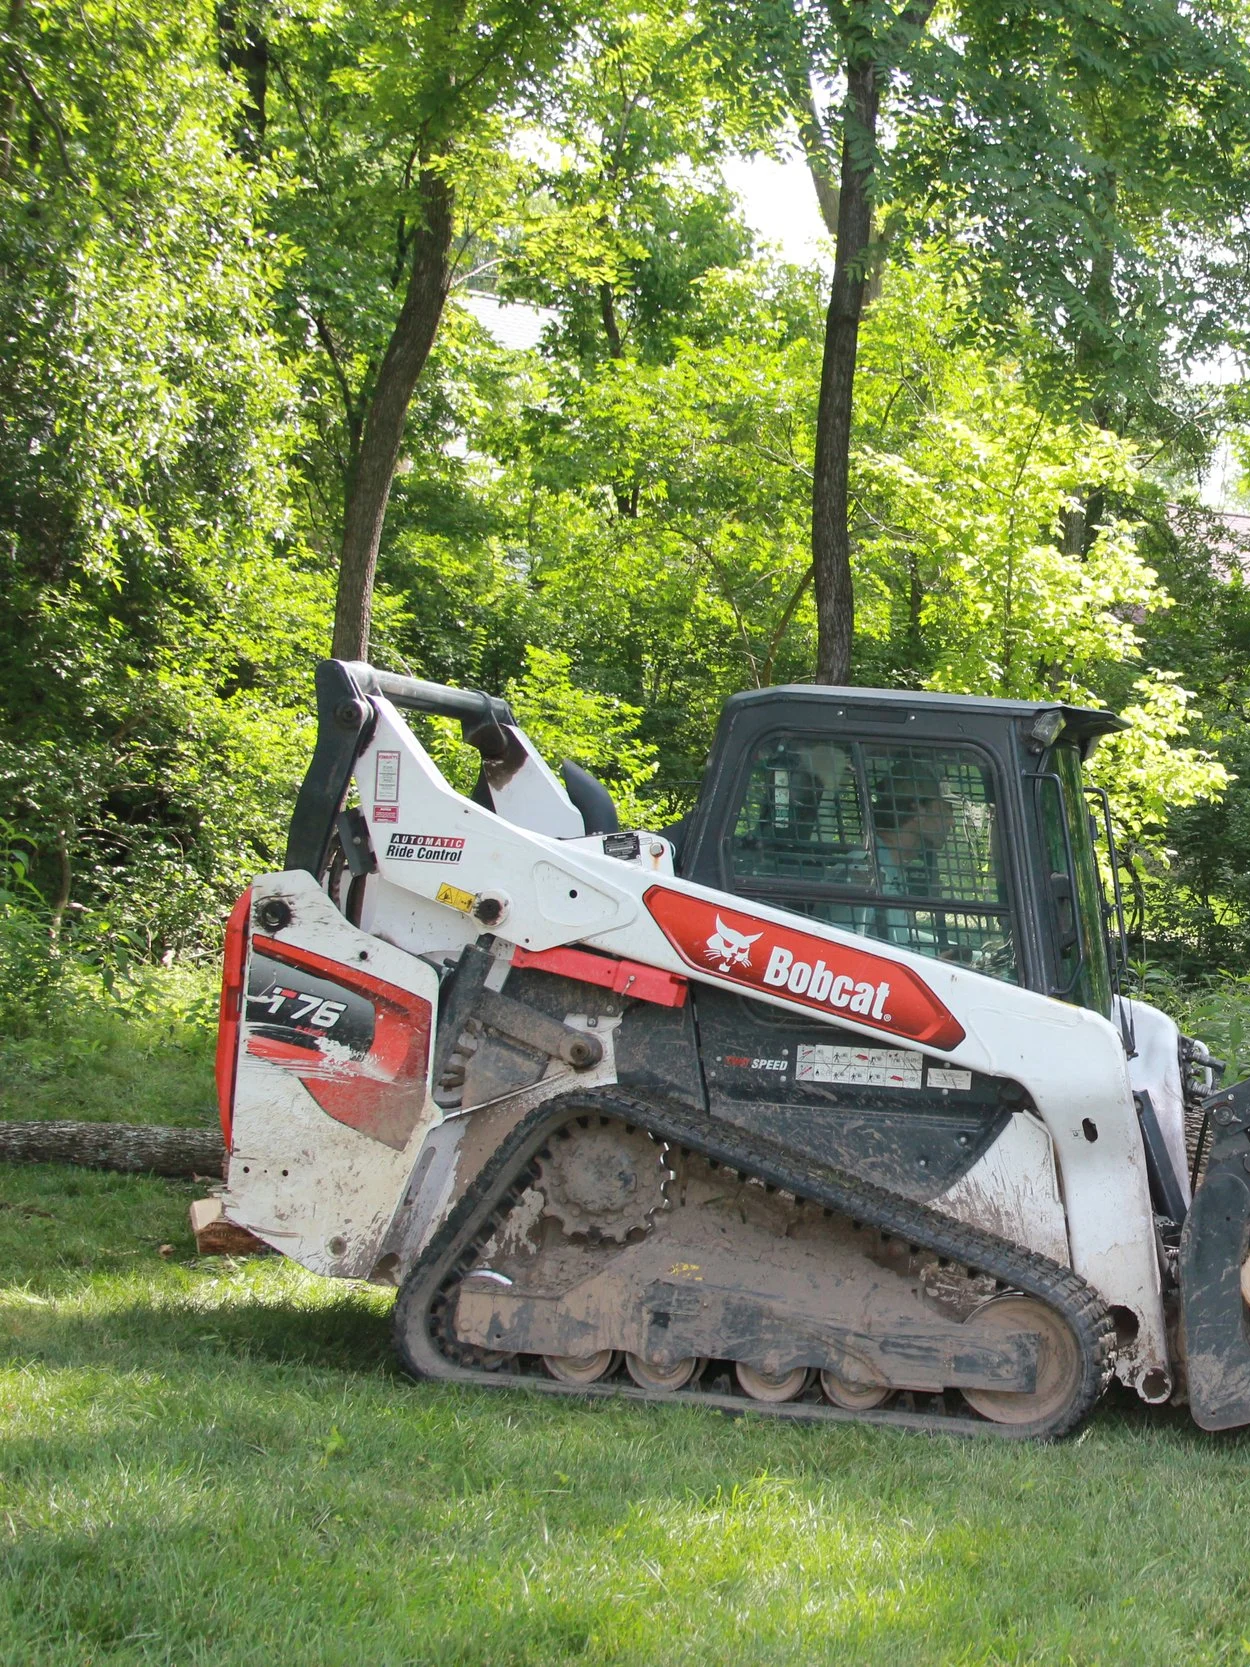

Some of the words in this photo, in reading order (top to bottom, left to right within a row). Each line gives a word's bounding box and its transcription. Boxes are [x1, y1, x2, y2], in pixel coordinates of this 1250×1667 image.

[393, 834, 463, 848] AUTOMATIC
[386, 844, 415, 859] Ride
[417, 847, 463, 862] Control
[763, 945, 890, 1020] Bobcat
[267, 986, 348, 1028] T76
[751, 1058, 788, 1071] SPEED
